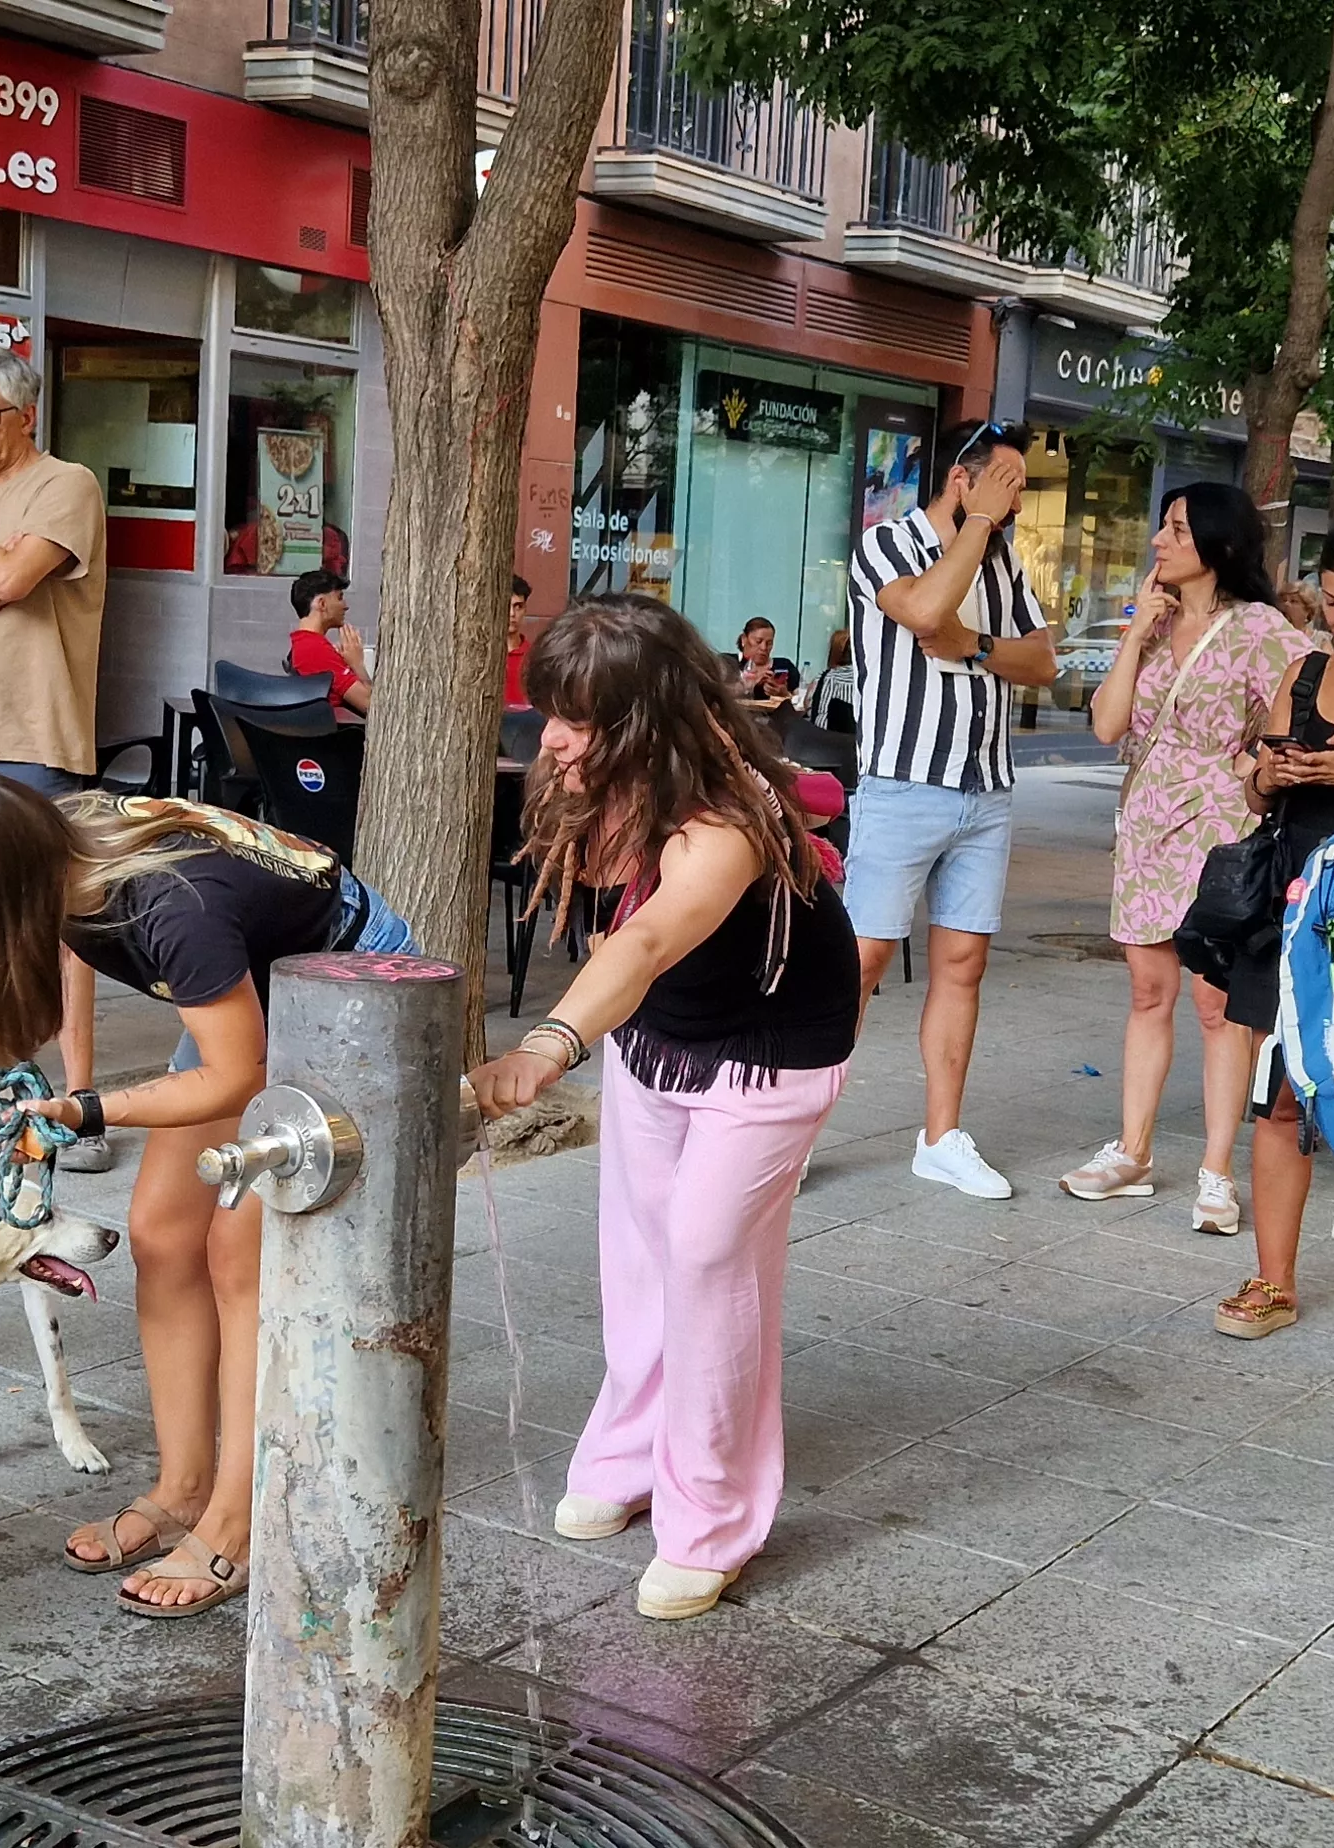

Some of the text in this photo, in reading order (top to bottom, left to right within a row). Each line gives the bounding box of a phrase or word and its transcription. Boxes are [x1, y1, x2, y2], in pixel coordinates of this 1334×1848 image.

[759, 400, 817, 424] FUNDACIÓN
[277, 484, 320, 518] 2x1
[573, 505, 629, 532] Sala de
[571, 538, 669, 566] Exposiciones
